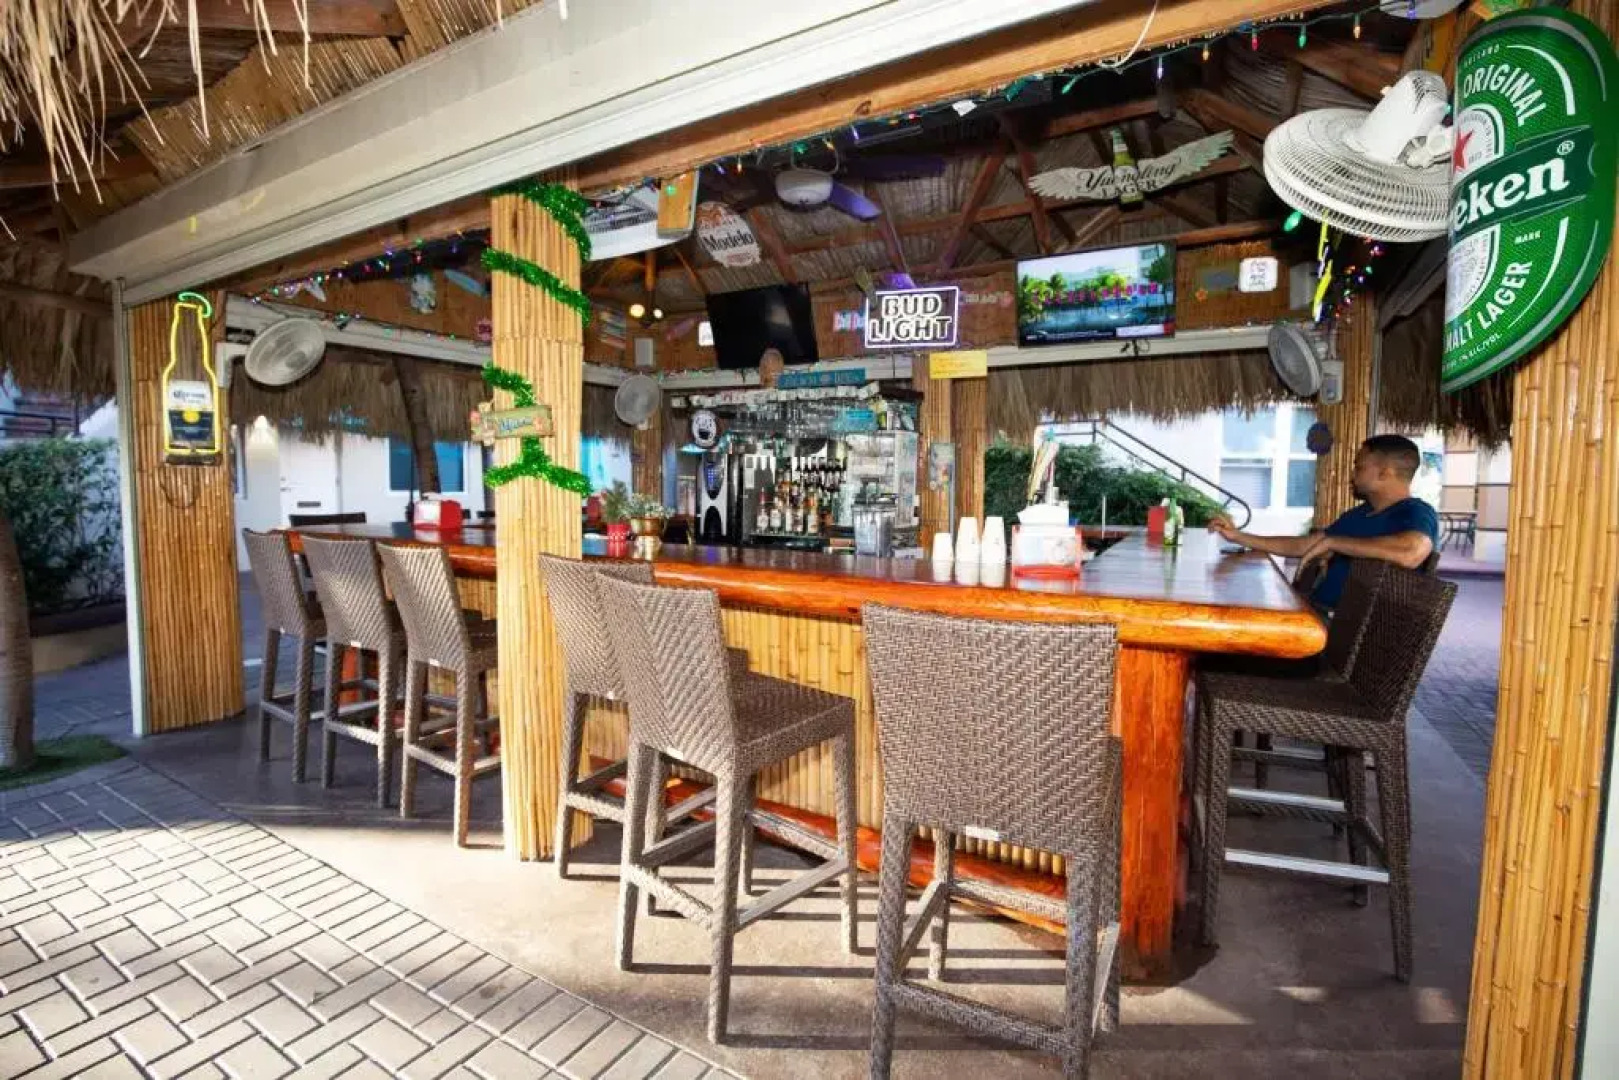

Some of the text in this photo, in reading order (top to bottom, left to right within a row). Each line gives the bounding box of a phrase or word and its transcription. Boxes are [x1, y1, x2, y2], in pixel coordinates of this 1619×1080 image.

[1463, 64, 1547, 127] ORIGINAL
[1450, 158, 1570, 232] eken
[701, 229, 755, 251] Modelo
[1514, 230, 1542, 246] MARK
[881, 293, 943, 319] BUD
[1476, 260, 1533, 330] LAGER
[869, 315, 953, 342] LIGHT
